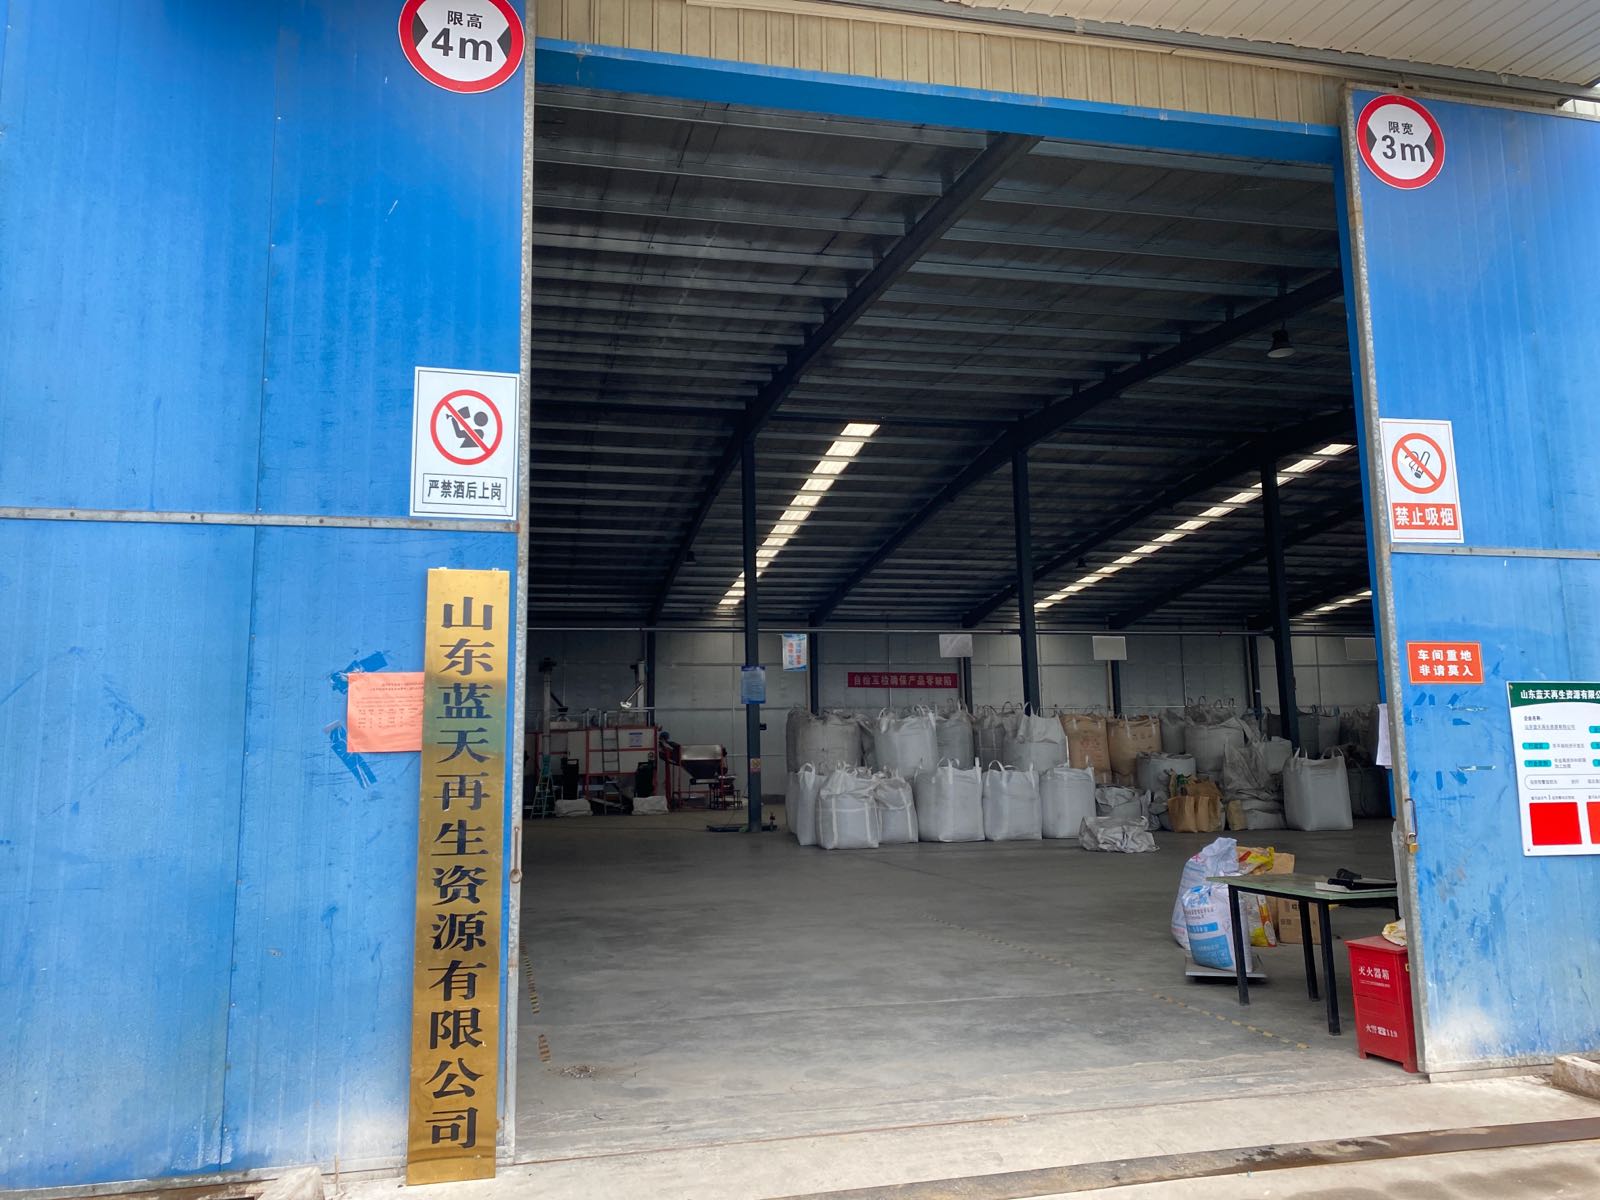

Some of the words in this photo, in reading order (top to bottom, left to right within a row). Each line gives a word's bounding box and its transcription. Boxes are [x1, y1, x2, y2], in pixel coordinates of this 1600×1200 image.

[447, 10, 483, 29] 限高
[431, 27, 493, 62] 4m
[1388, 121, 1414, 135] 限宽
[1381, 134, 1425, 162] 3m
[427, 479, 502, 501] 严禁酒后上岗
[1395, 506, 1455, 526] 禁止吸烟
[1417, 649, 1472, 662] 车间重地
[1418, 664, 1474, 677] 非请莫入
[424, 595, 495, 1151] 山东蓝天再生资源有限公司
